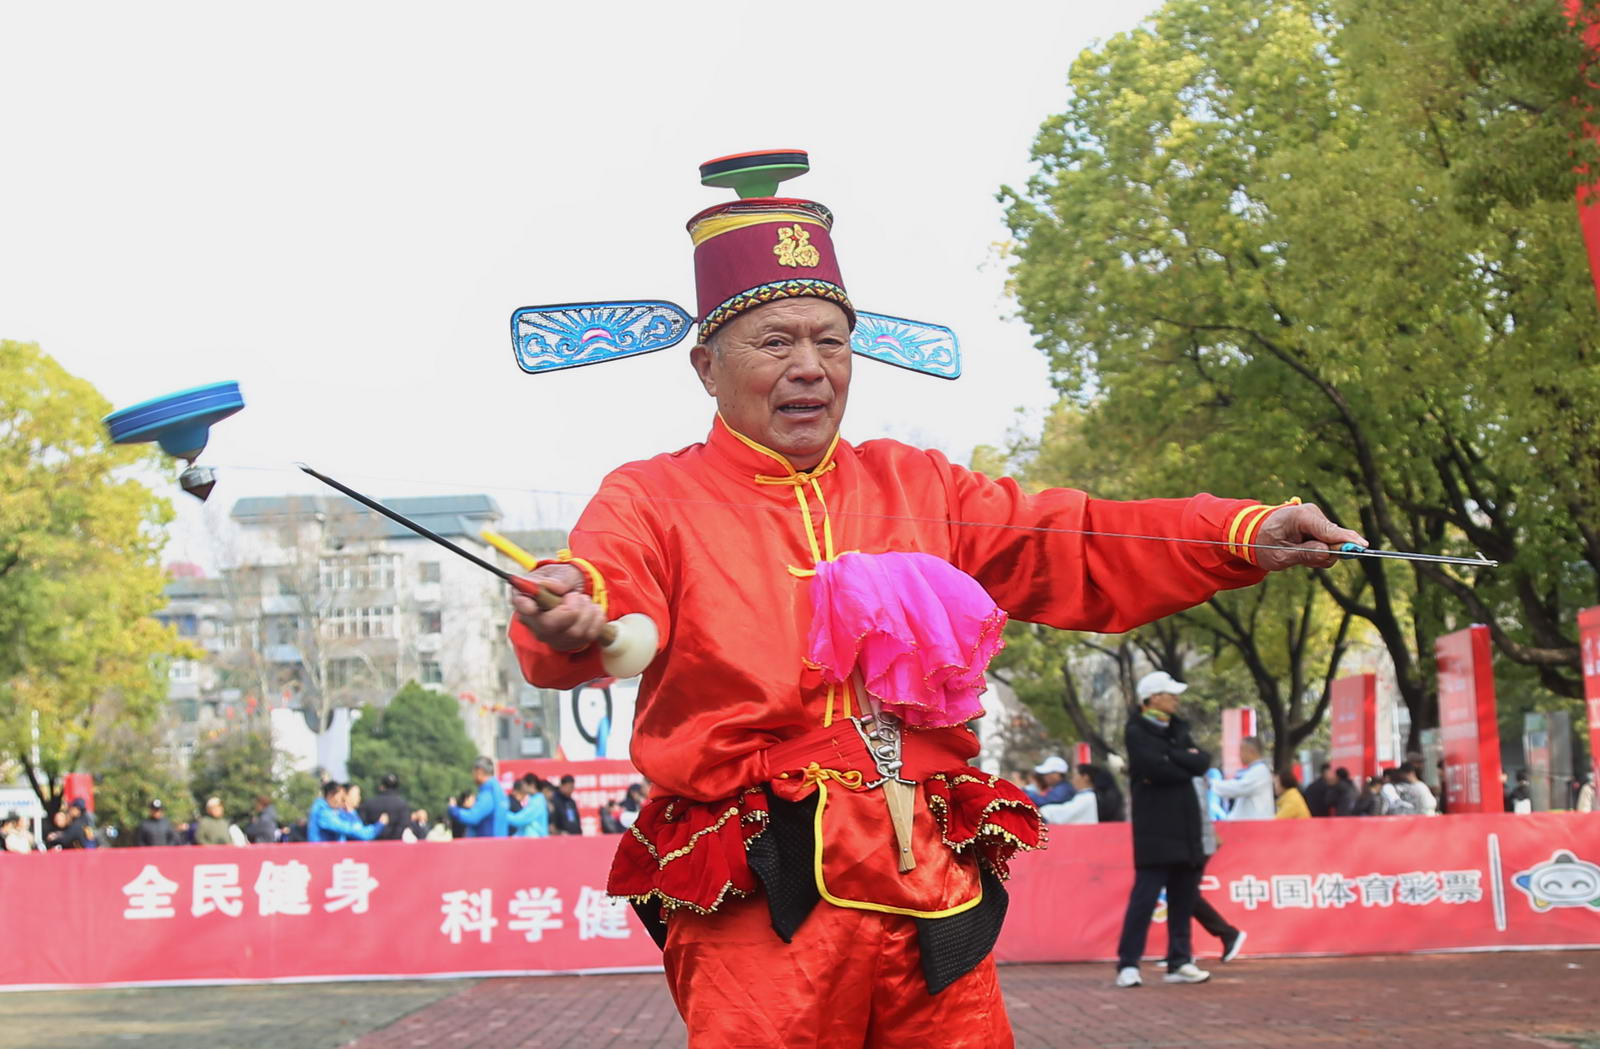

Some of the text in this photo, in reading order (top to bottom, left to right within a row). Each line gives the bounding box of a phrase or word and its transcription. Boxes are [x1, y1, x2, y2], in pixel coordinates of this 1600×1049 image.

[122, 858, 379, 919] 全民健身
[440, 886, 650, 944] 科学健
[1230, 869, 1483, 909] 中国体育彩票
